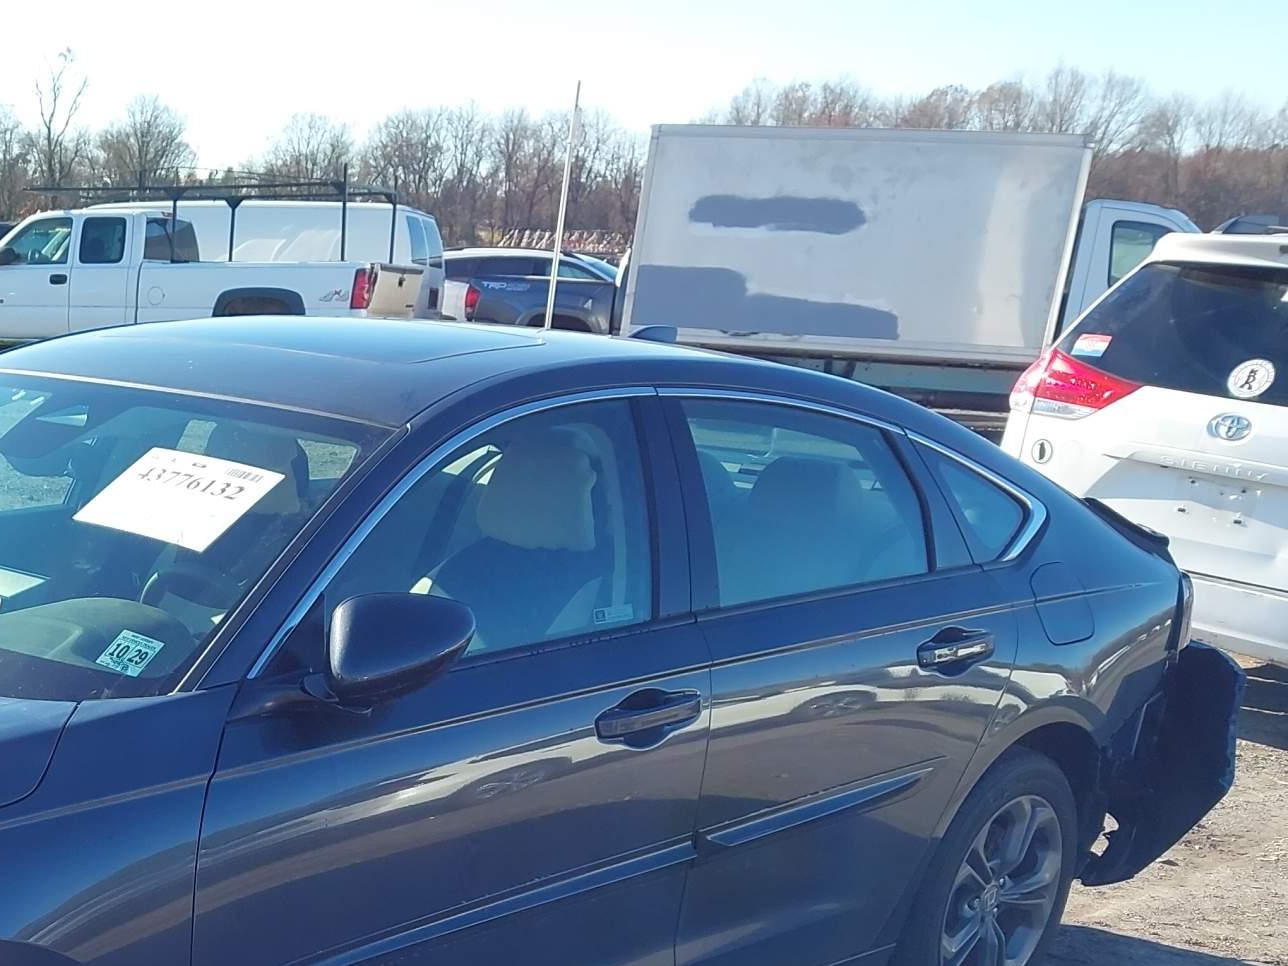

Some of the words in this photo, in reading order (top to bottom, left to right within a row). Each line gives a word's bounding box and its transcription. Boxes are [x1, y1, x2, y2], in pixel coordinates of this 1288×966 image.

[138, 467, 245, 500] 43776132
[108, 642, 130, 659] 10
[127, 648, 149, 666] 29
